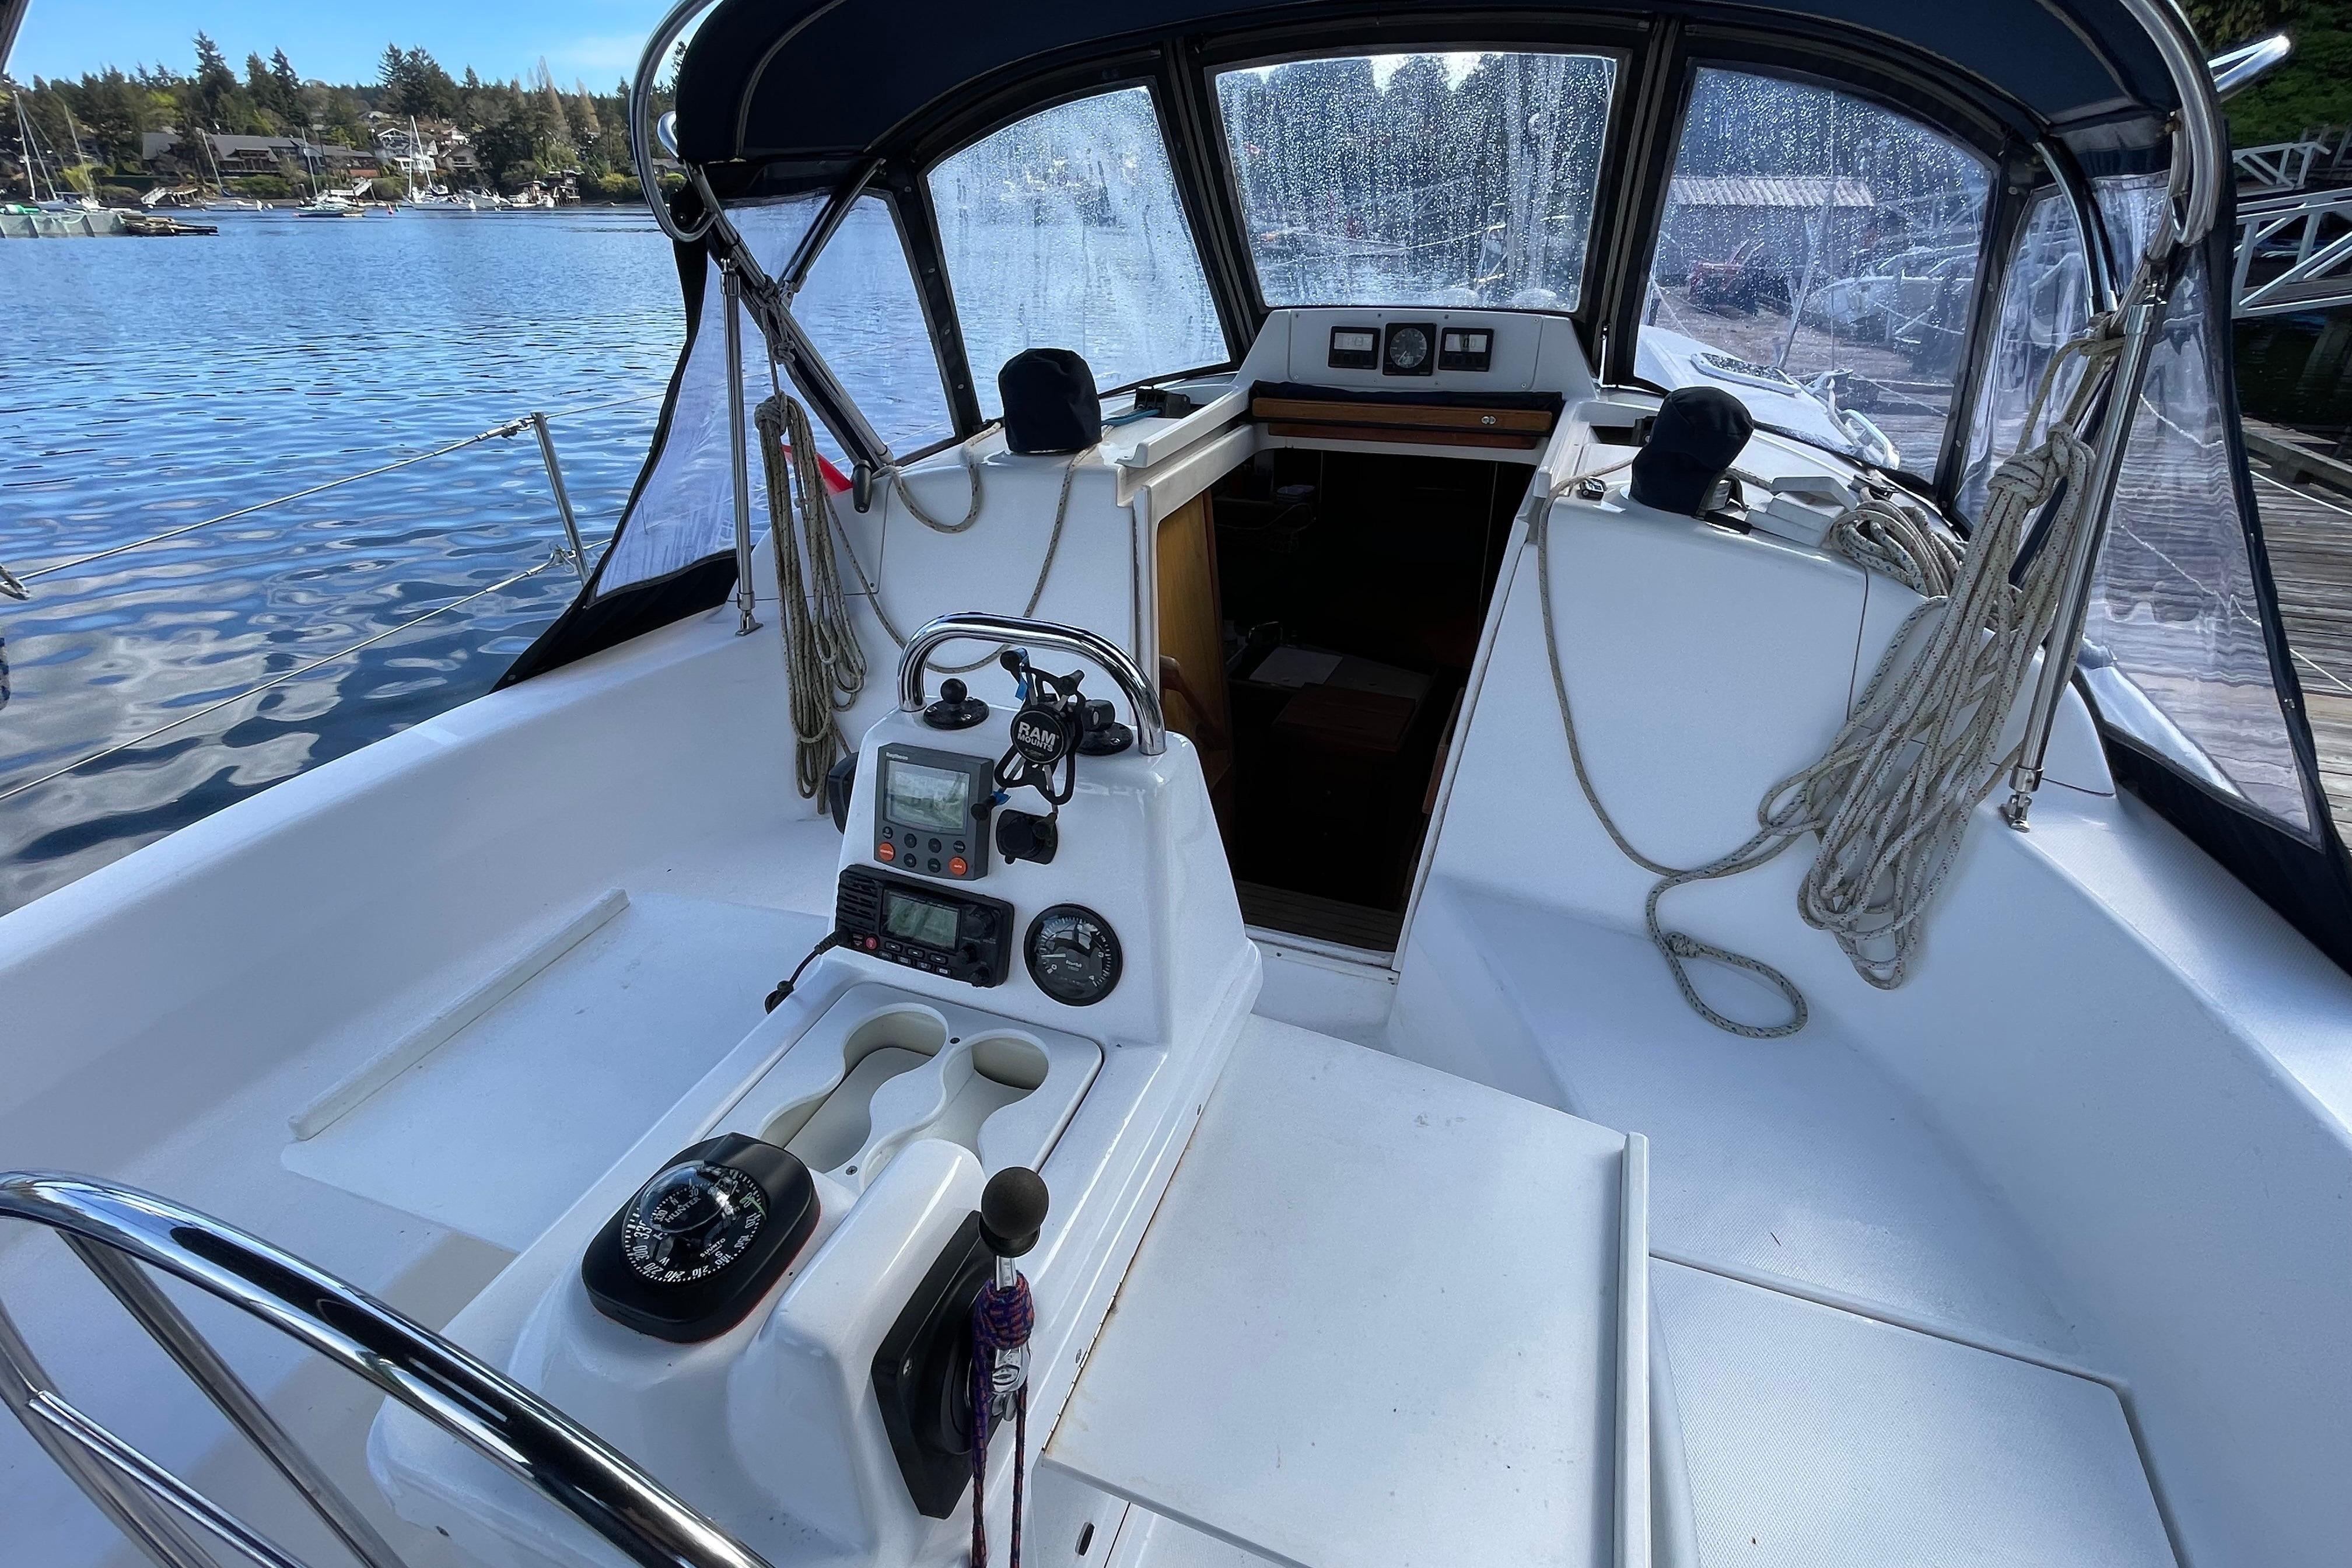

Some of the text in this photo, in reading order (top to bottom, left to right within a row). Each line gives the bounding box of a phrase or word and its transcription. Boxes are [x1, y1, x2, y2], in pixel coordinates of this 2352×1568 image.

[1017, 733, 1053, 752] MOUNTS
[1019, 721, 1056, 746] RAM
[689, 1188, 699, 1198] 30
[665, 1197, 701, 1223] HUNTER
[700, 1238, 726, 1257] SUUNTO
[659, 1256, 670, 1266] W
